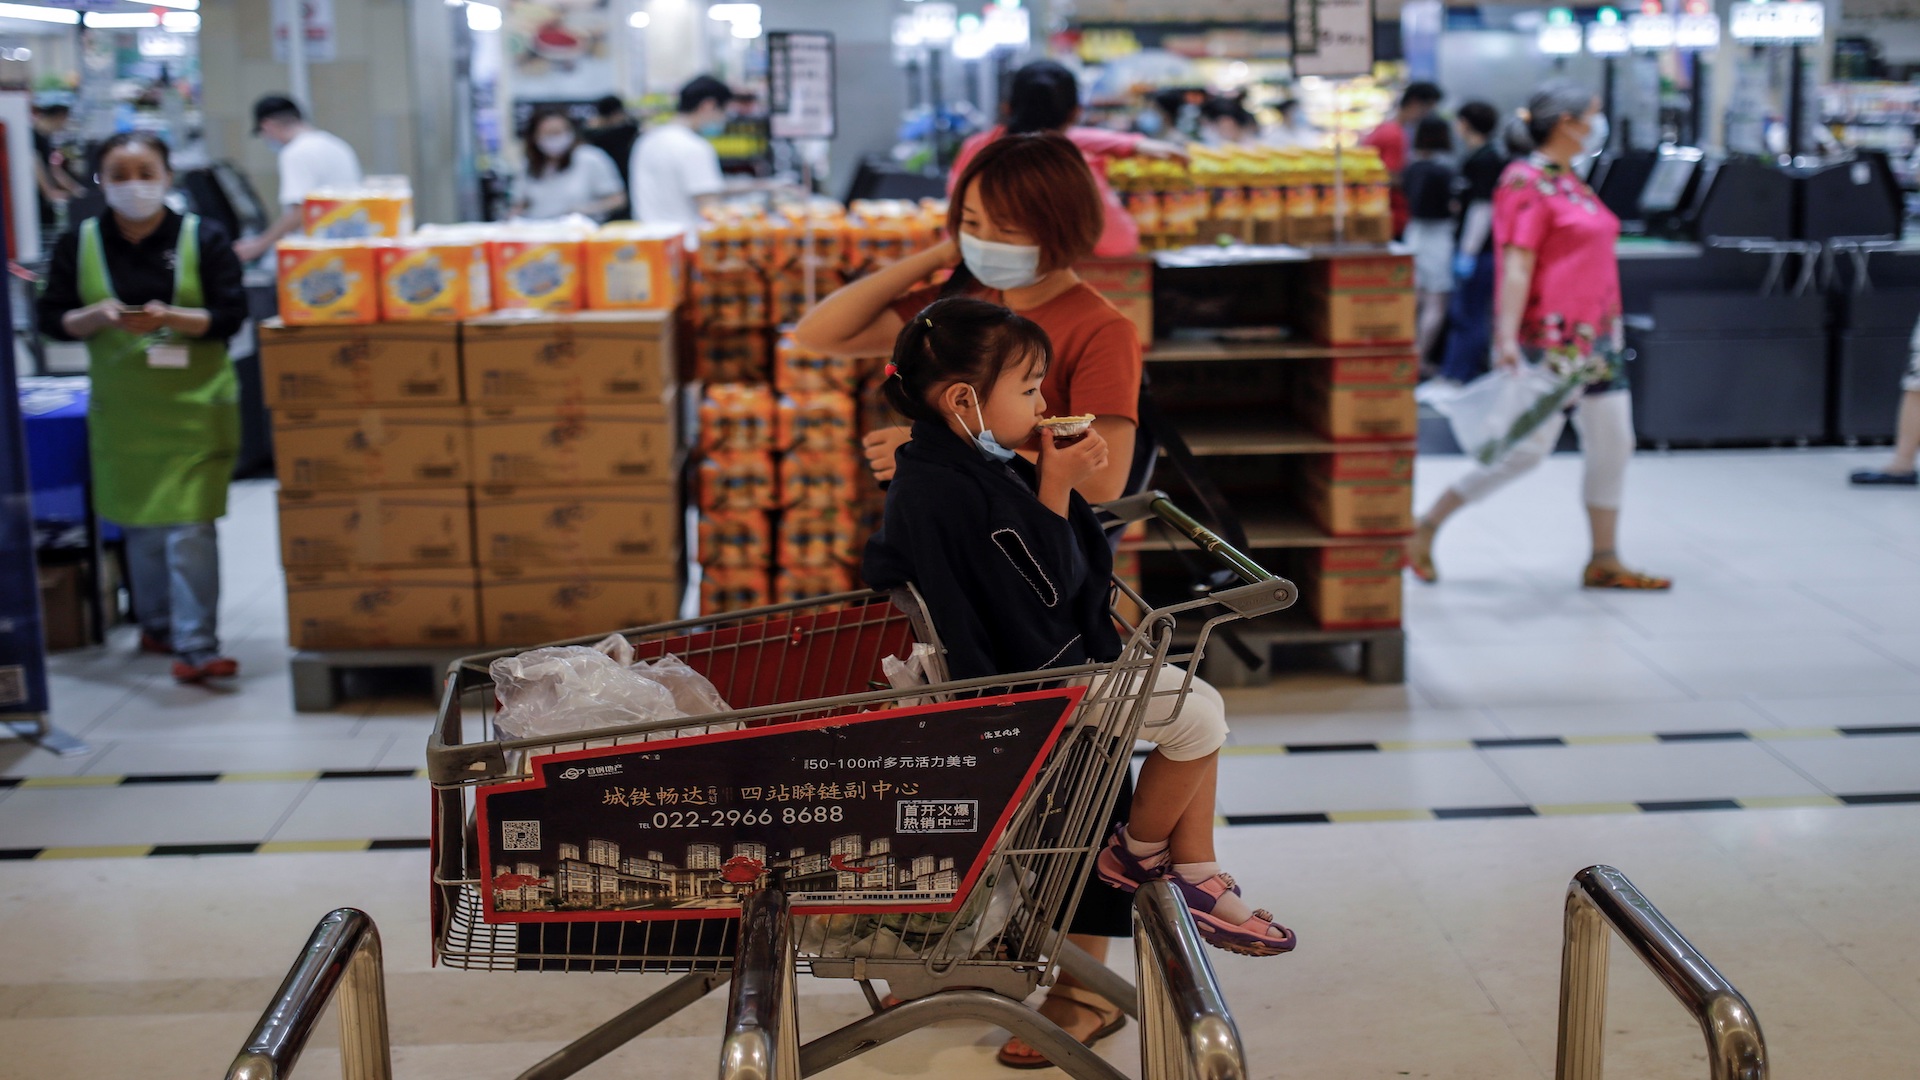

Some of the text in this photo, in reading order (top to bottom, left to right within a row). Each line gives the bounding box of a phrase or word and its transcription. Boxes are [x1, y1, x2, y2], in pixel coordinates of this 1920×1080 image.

[602, 785, 708, 807] 城铁畅达
[740, 780, 920, 802] 四站瞬链副中心
[638, 805, 844, 830] TEL 022-2966 8688
[904, 804, 969, 817] 首开火爆
[903, 816, 952, 829] 热销中
